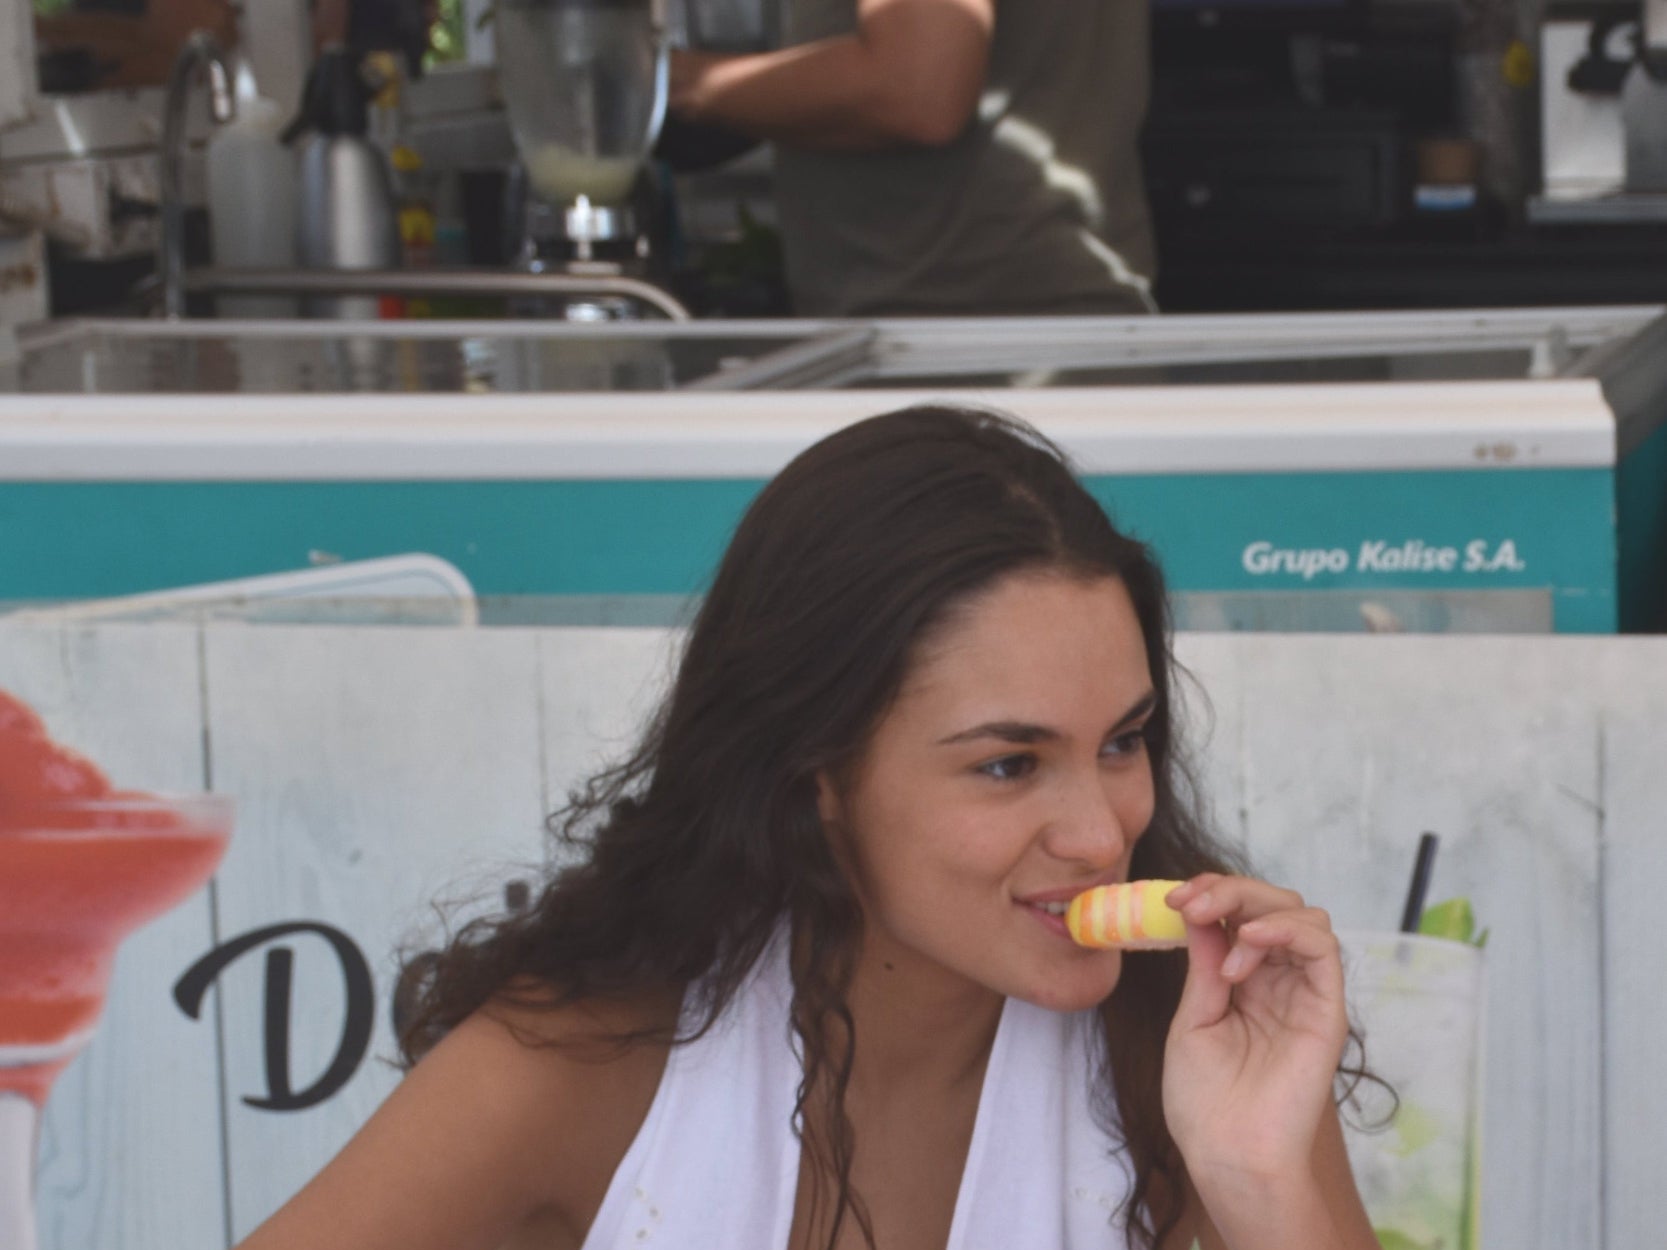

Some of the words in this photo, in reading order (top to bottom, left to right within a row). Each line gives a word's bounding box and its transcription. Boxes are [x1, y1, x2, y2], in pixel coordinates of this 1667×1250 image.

[1243, 541, 1349, 580] Grupo
[1356, 539, 1458, 572] Kalise
[1463, 538, 1526, 572] S.A.
